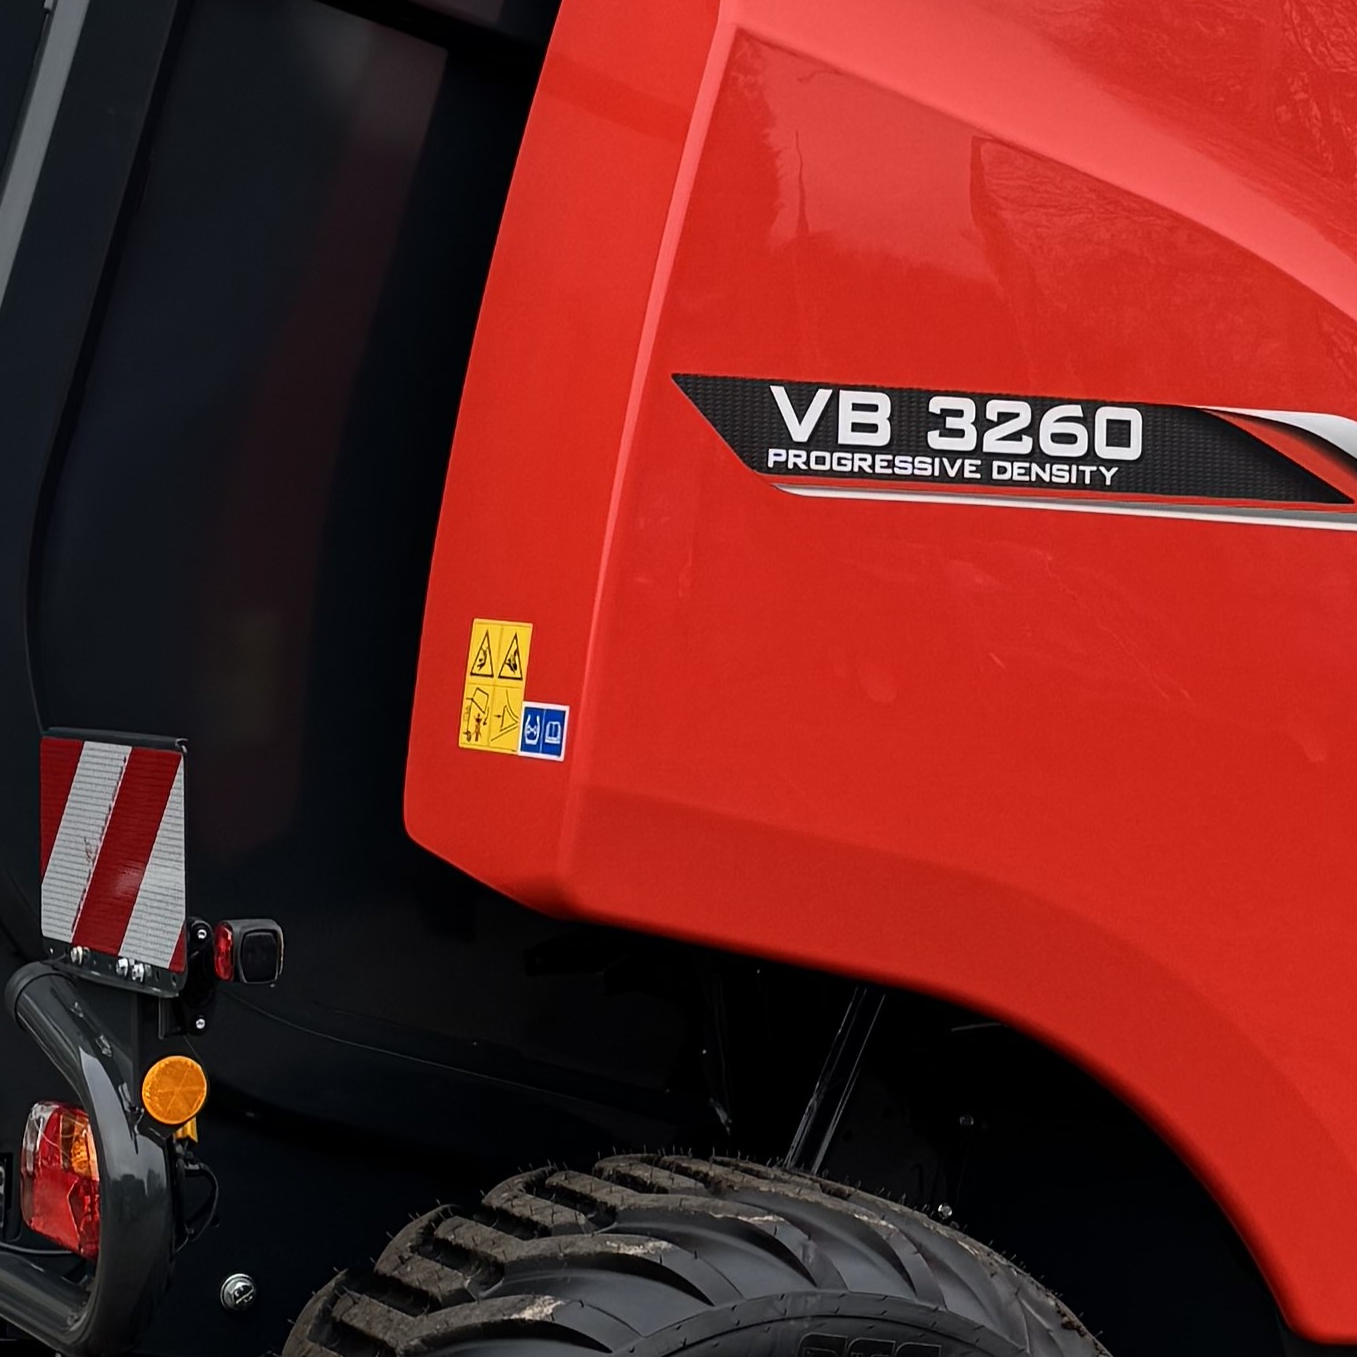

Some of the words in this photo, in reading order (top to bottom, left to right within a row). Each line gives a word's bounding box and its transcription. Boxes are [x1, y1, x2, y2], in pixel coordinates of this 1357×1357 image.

[769, 385, 892, 447] VB
[926, 395, 1144, 461] 3260
[767, 448, 982, 479] PROGRESSIVE
[991, 460, 1119, 486] DENSITY
